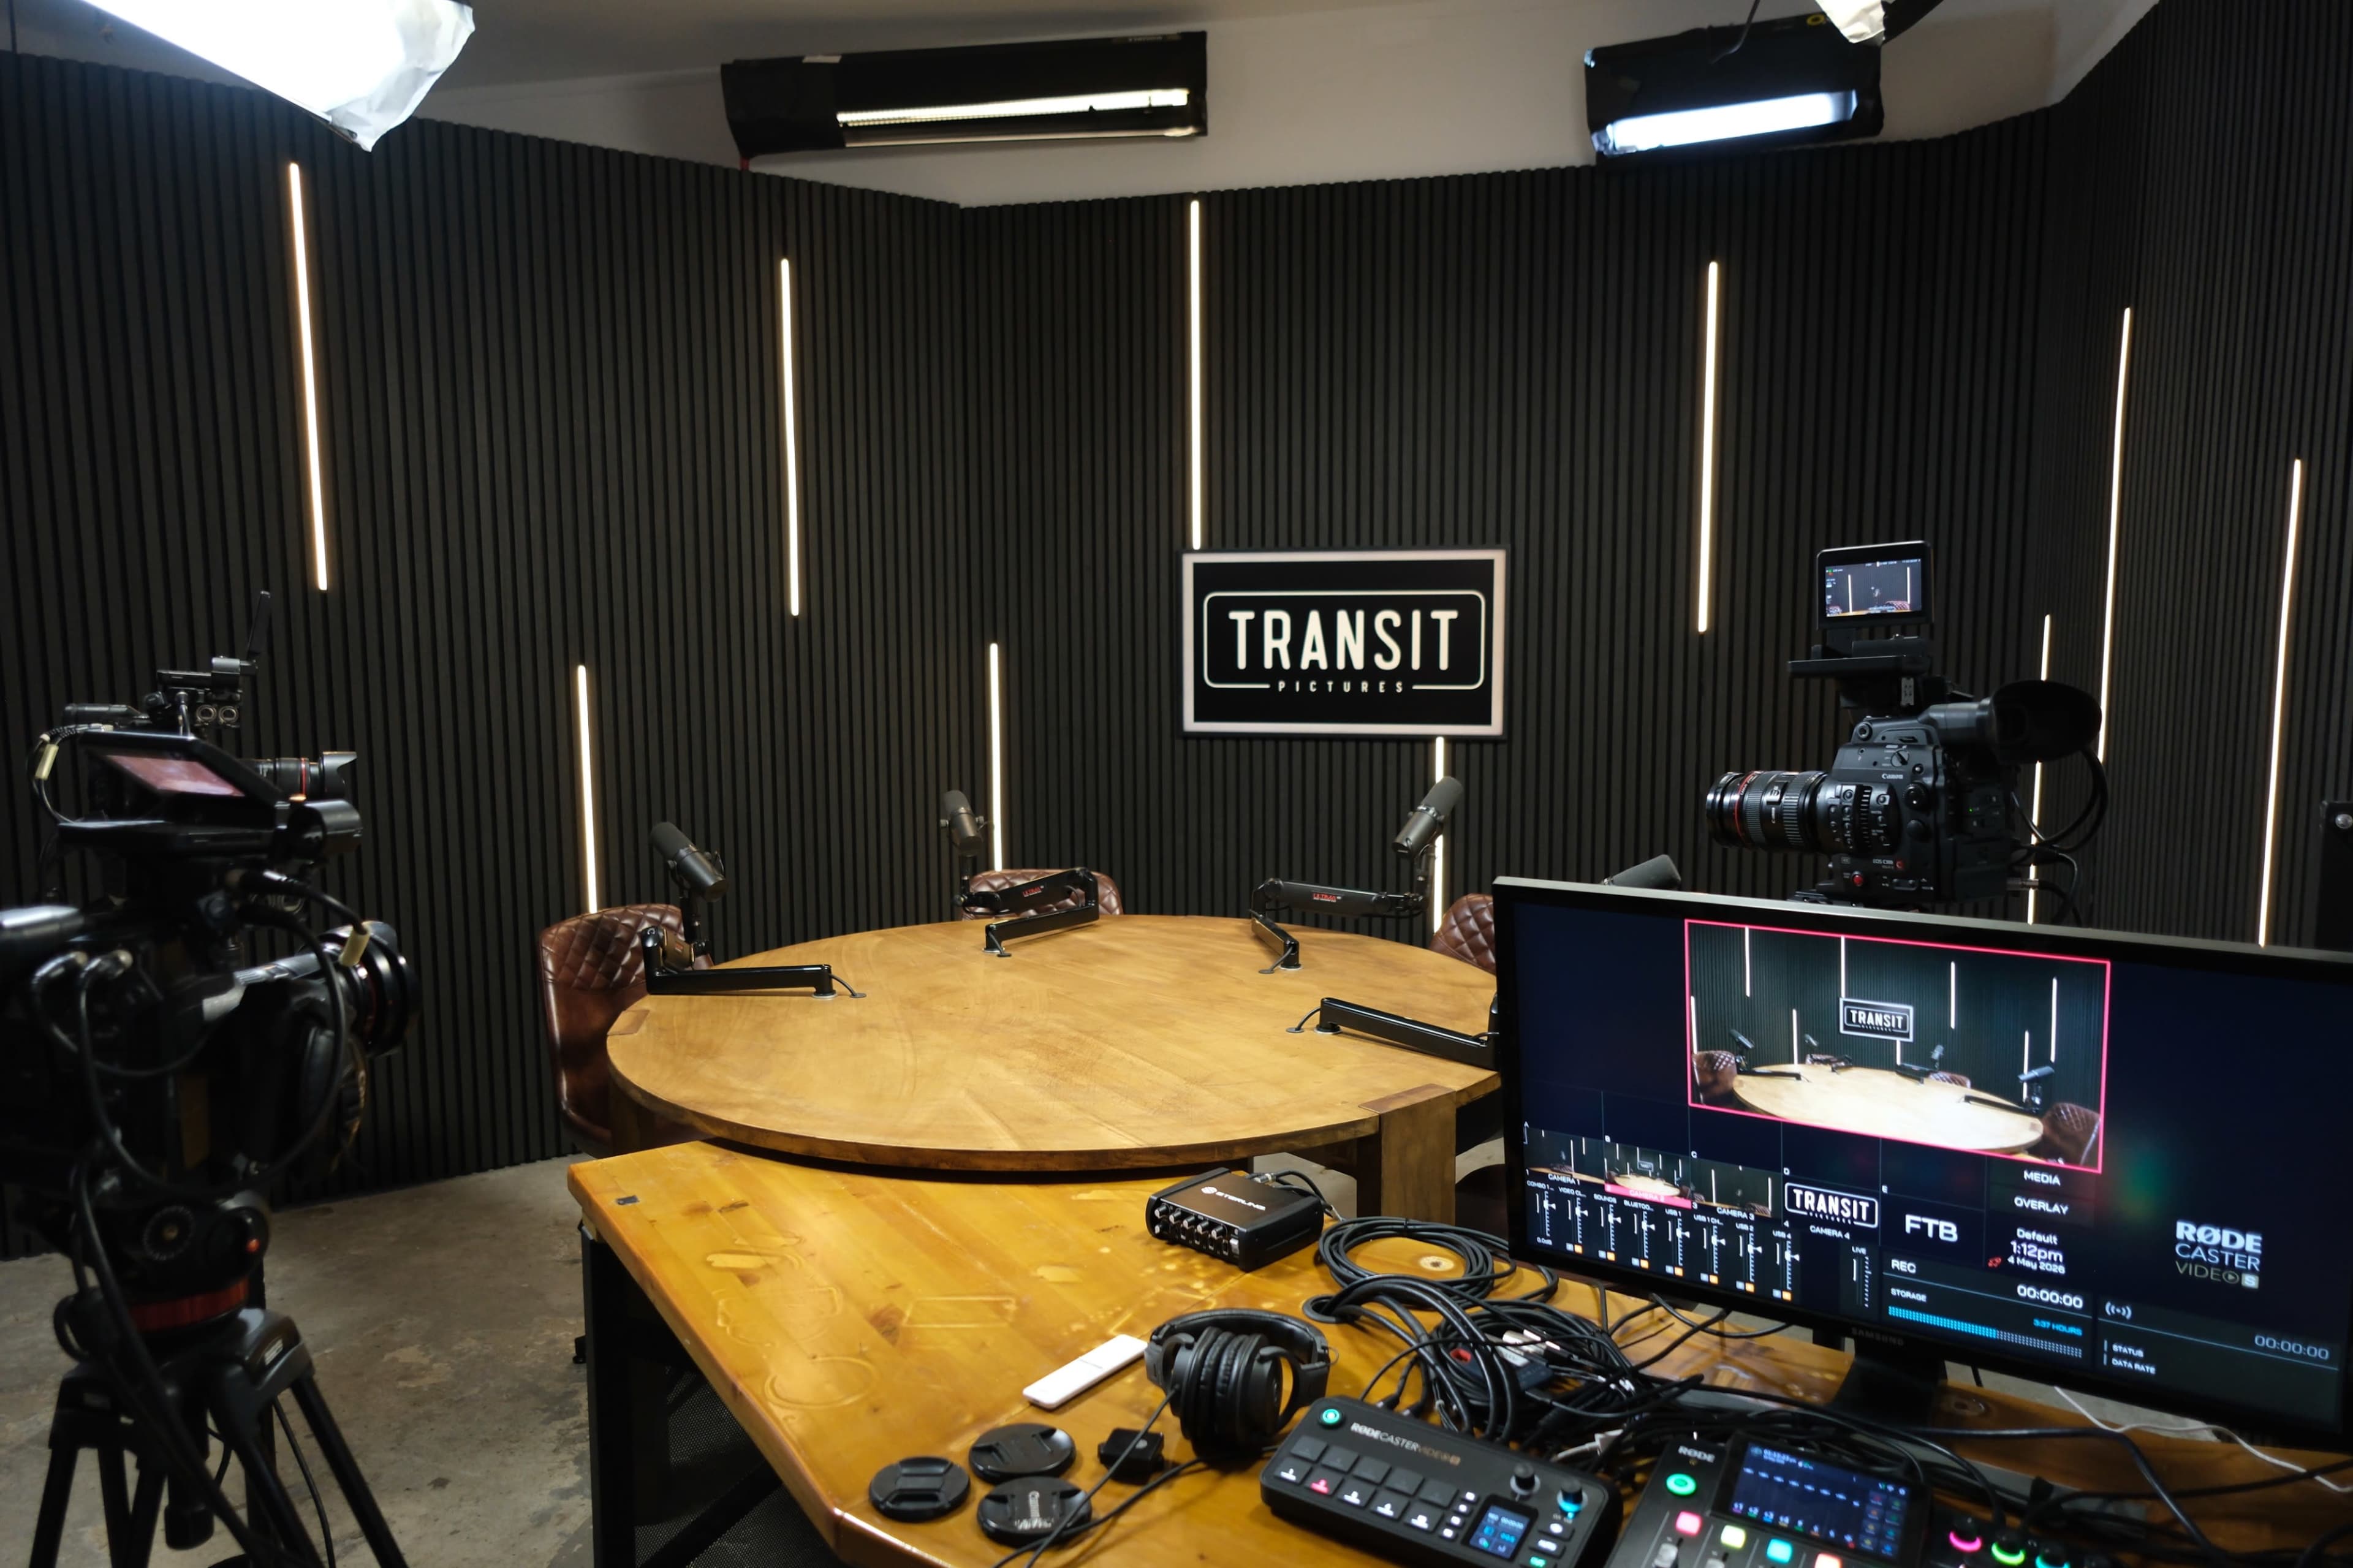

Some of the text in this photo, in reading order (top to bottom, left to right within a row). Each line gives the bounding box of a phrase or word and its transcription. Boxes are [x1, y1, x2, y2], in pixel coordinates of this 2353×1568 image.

[1229, 608, 1458, 670] TRANSIT
[1278, 680, 1403, 693] PICTURES
[1851, 1009, 1903, 1029] TRANSIT
[1526, 1180, 1546, 1189] COMBO
[1548, 1173, 1575, 1185] CAMERA
[2023, 1170, 2061, 1186] MEDIA
[1558, 1186, 1575, 1195] VIDEO
[1629, 1189, 1659, 1201] CAMERA
[1882, 1185, 1888, 1194] E
[1593, 1194, 1617, 1204] SOUNDS
[1793, 1189, 1870, 1221] TRANSIT
[2014, 1196, 2069, 1215] OVERLAY
[1716, 1207, 1748, 1219] CAMERA
[1809, 1225, 1843, 1238] CAMERA
[1904, 1214, 1958, 1243] FTB
[2016, 1227, 2058, 1245] Default
[2176, 1221, 2262, 1254] RØDE
[1852, 1246, 1866, 1255] LIVE
[2010, 1240, 2064, 1262] 1:12pm
[2175, 1243, 2260, 1271] CASTER
[1891, 1259, 1917, 1273] REC
[2007, 1255, 2015, 1265] 4
[2017, 1256, 2037, 1270] May
[1891, 1288, 1927, 1303] STORAGE
[2017, 1284, 2083, 1308] 00:00:00
[2052, 1323, 2082, 1336] HOURS
[2112, 1343, 2144, 1358] STATUS
[2254, 1334, 2329, 1360] 00:00:00
[2112, 1358, 2156, 1374] DATA RATE
